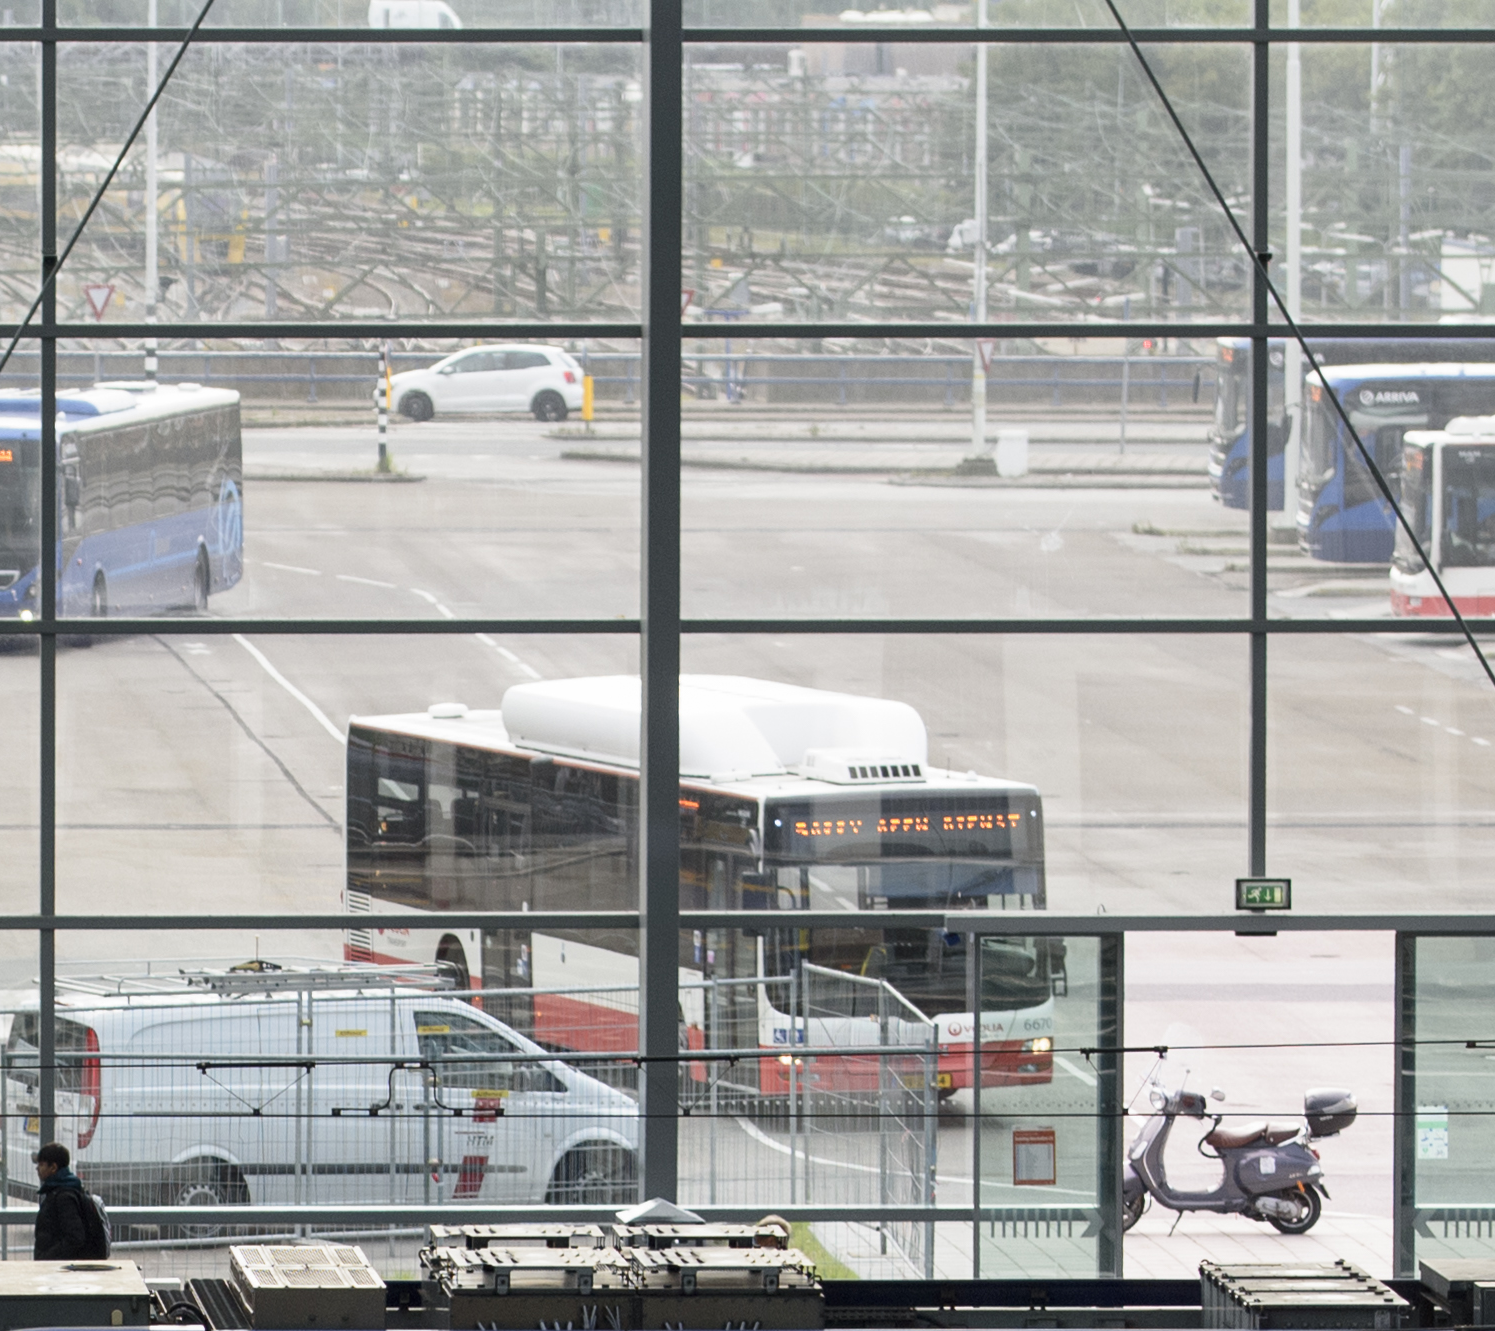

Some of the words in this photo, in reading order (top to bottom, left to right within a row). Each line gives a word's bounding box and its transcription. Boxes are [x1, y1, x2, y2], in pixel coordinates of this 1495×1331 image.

[1374, 391, 1420, 403] ARRIVA
[963, 1022, 1004, 1034] VOLIA
[1023, 1017, 1052, 1031] 6670
[466, 1134, 495, 1147] HTM
